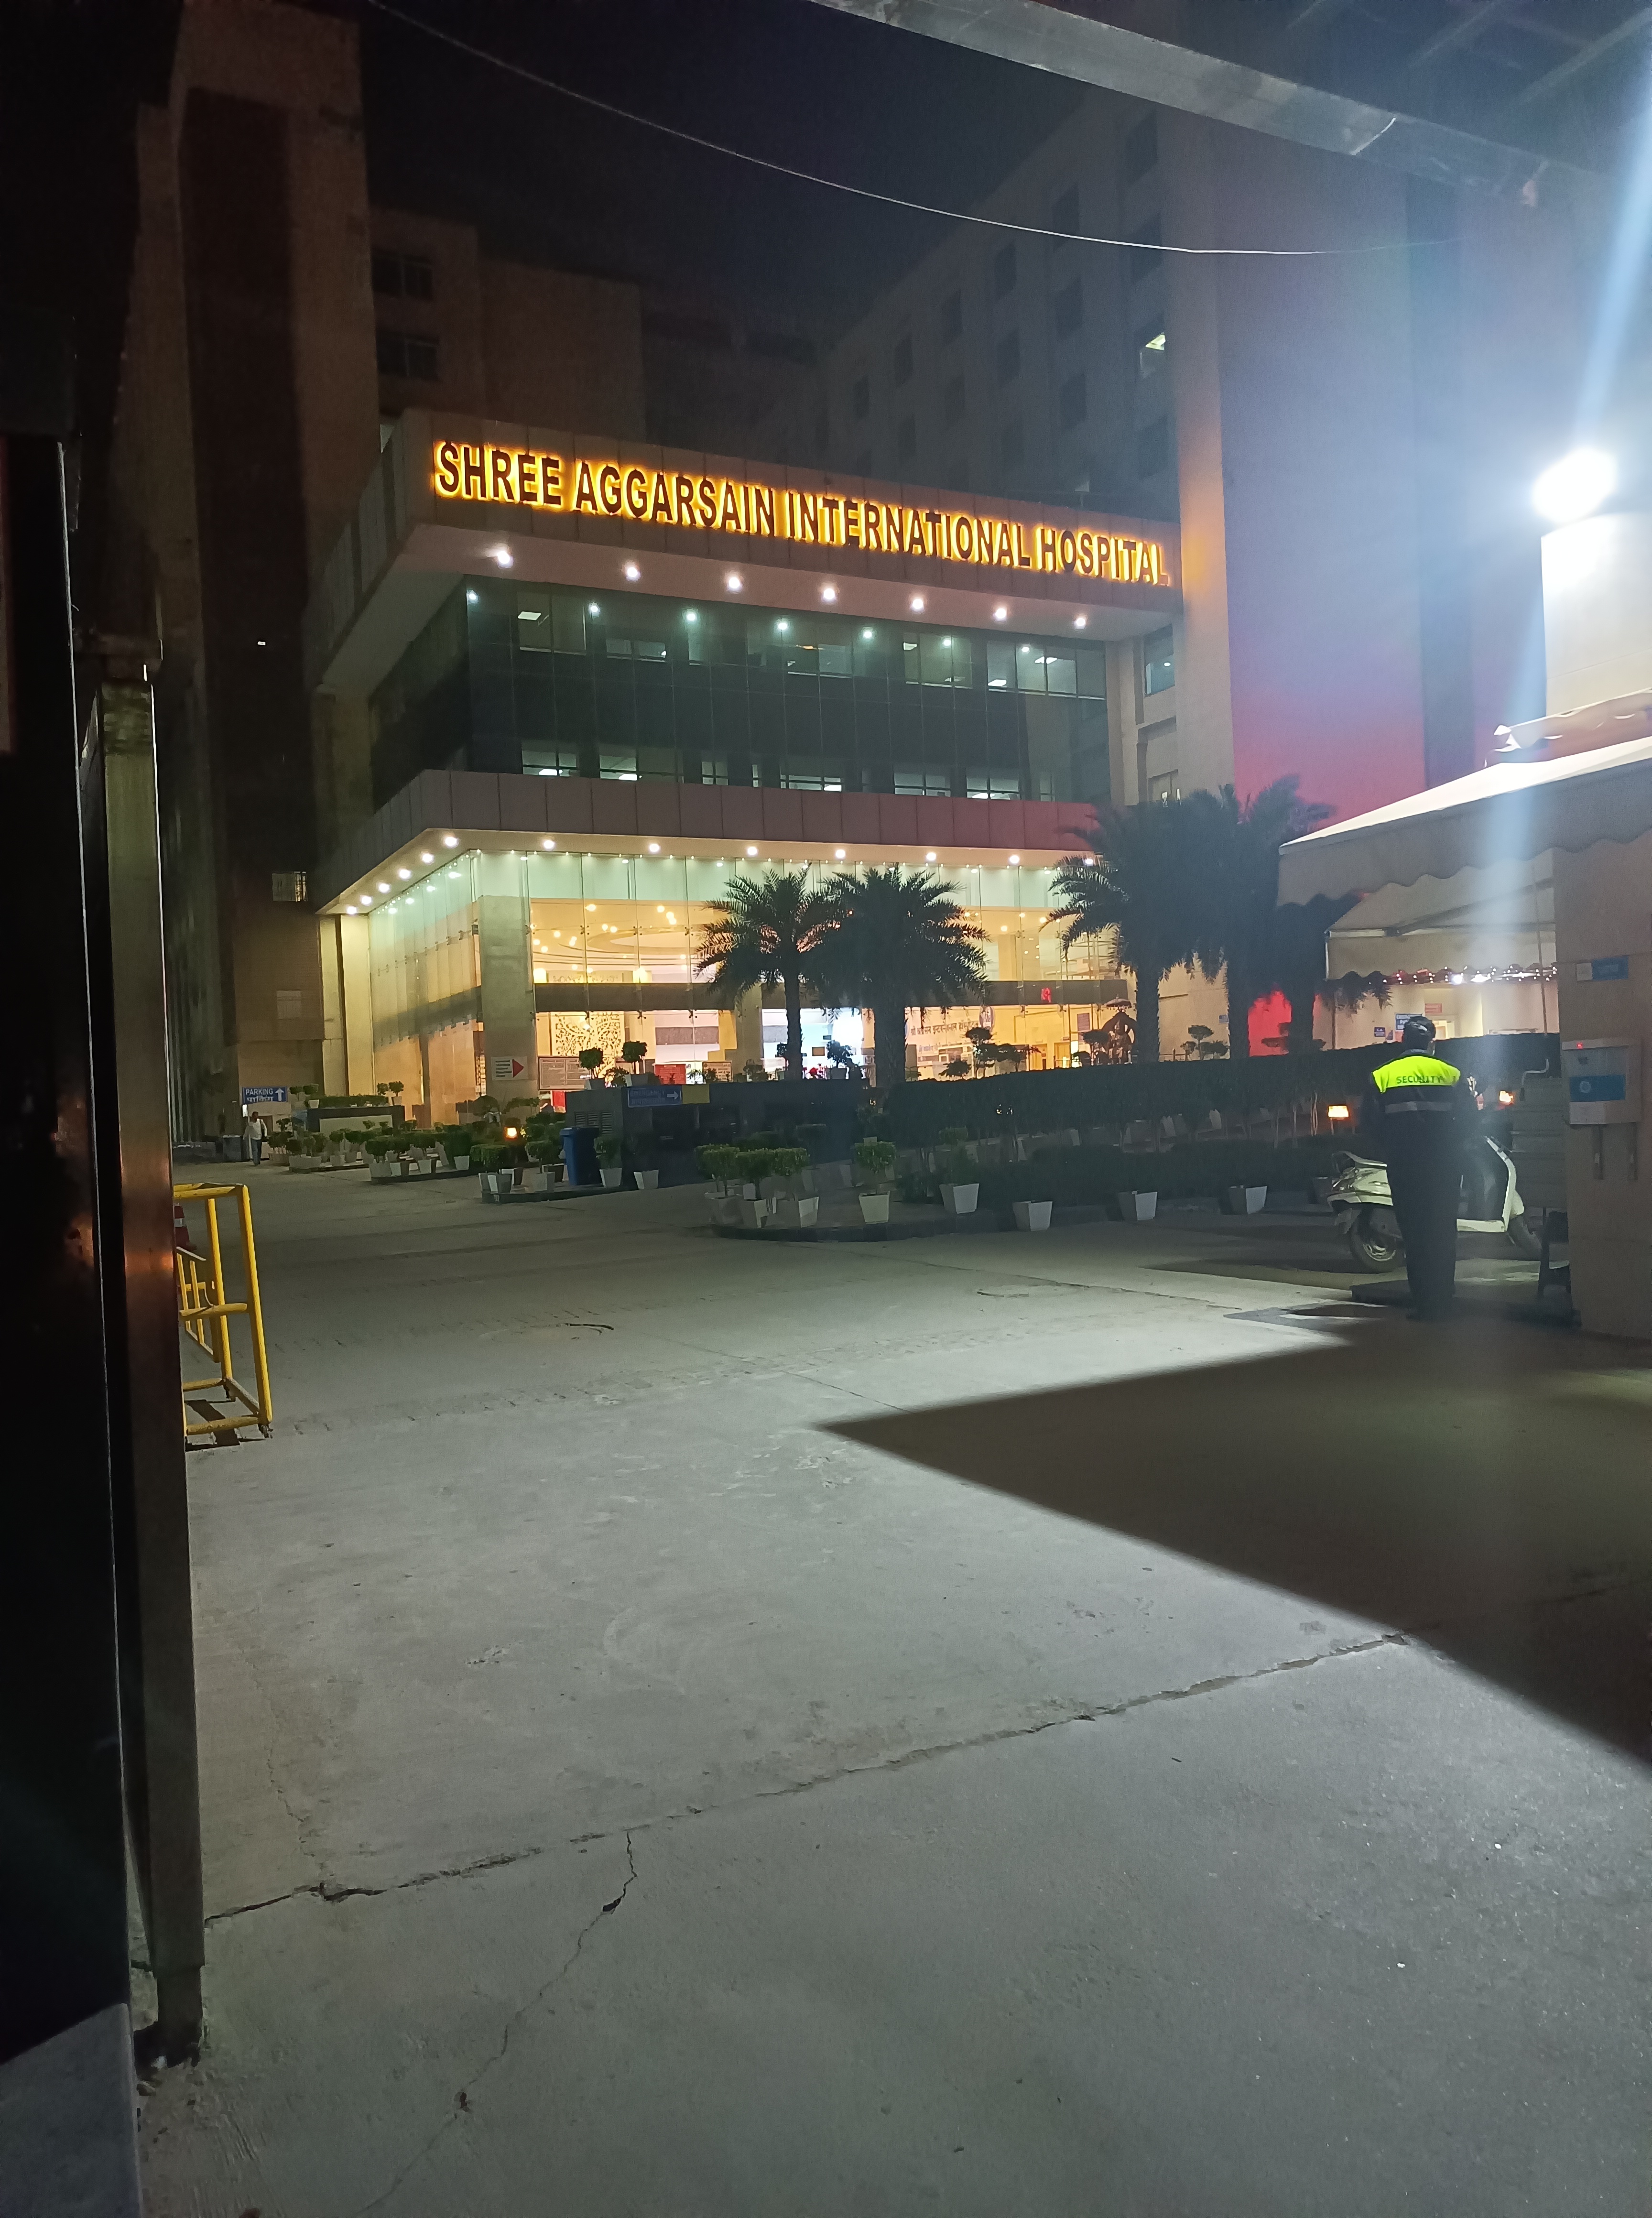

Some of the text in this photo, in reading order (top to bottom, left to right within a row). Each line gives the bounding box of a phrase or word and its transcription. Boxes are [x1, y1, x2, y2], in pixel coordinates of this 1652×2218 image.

[438, 441, 1168, 586] SHREE AGGARSAIN INTERNATIONAL HOSPITAL
